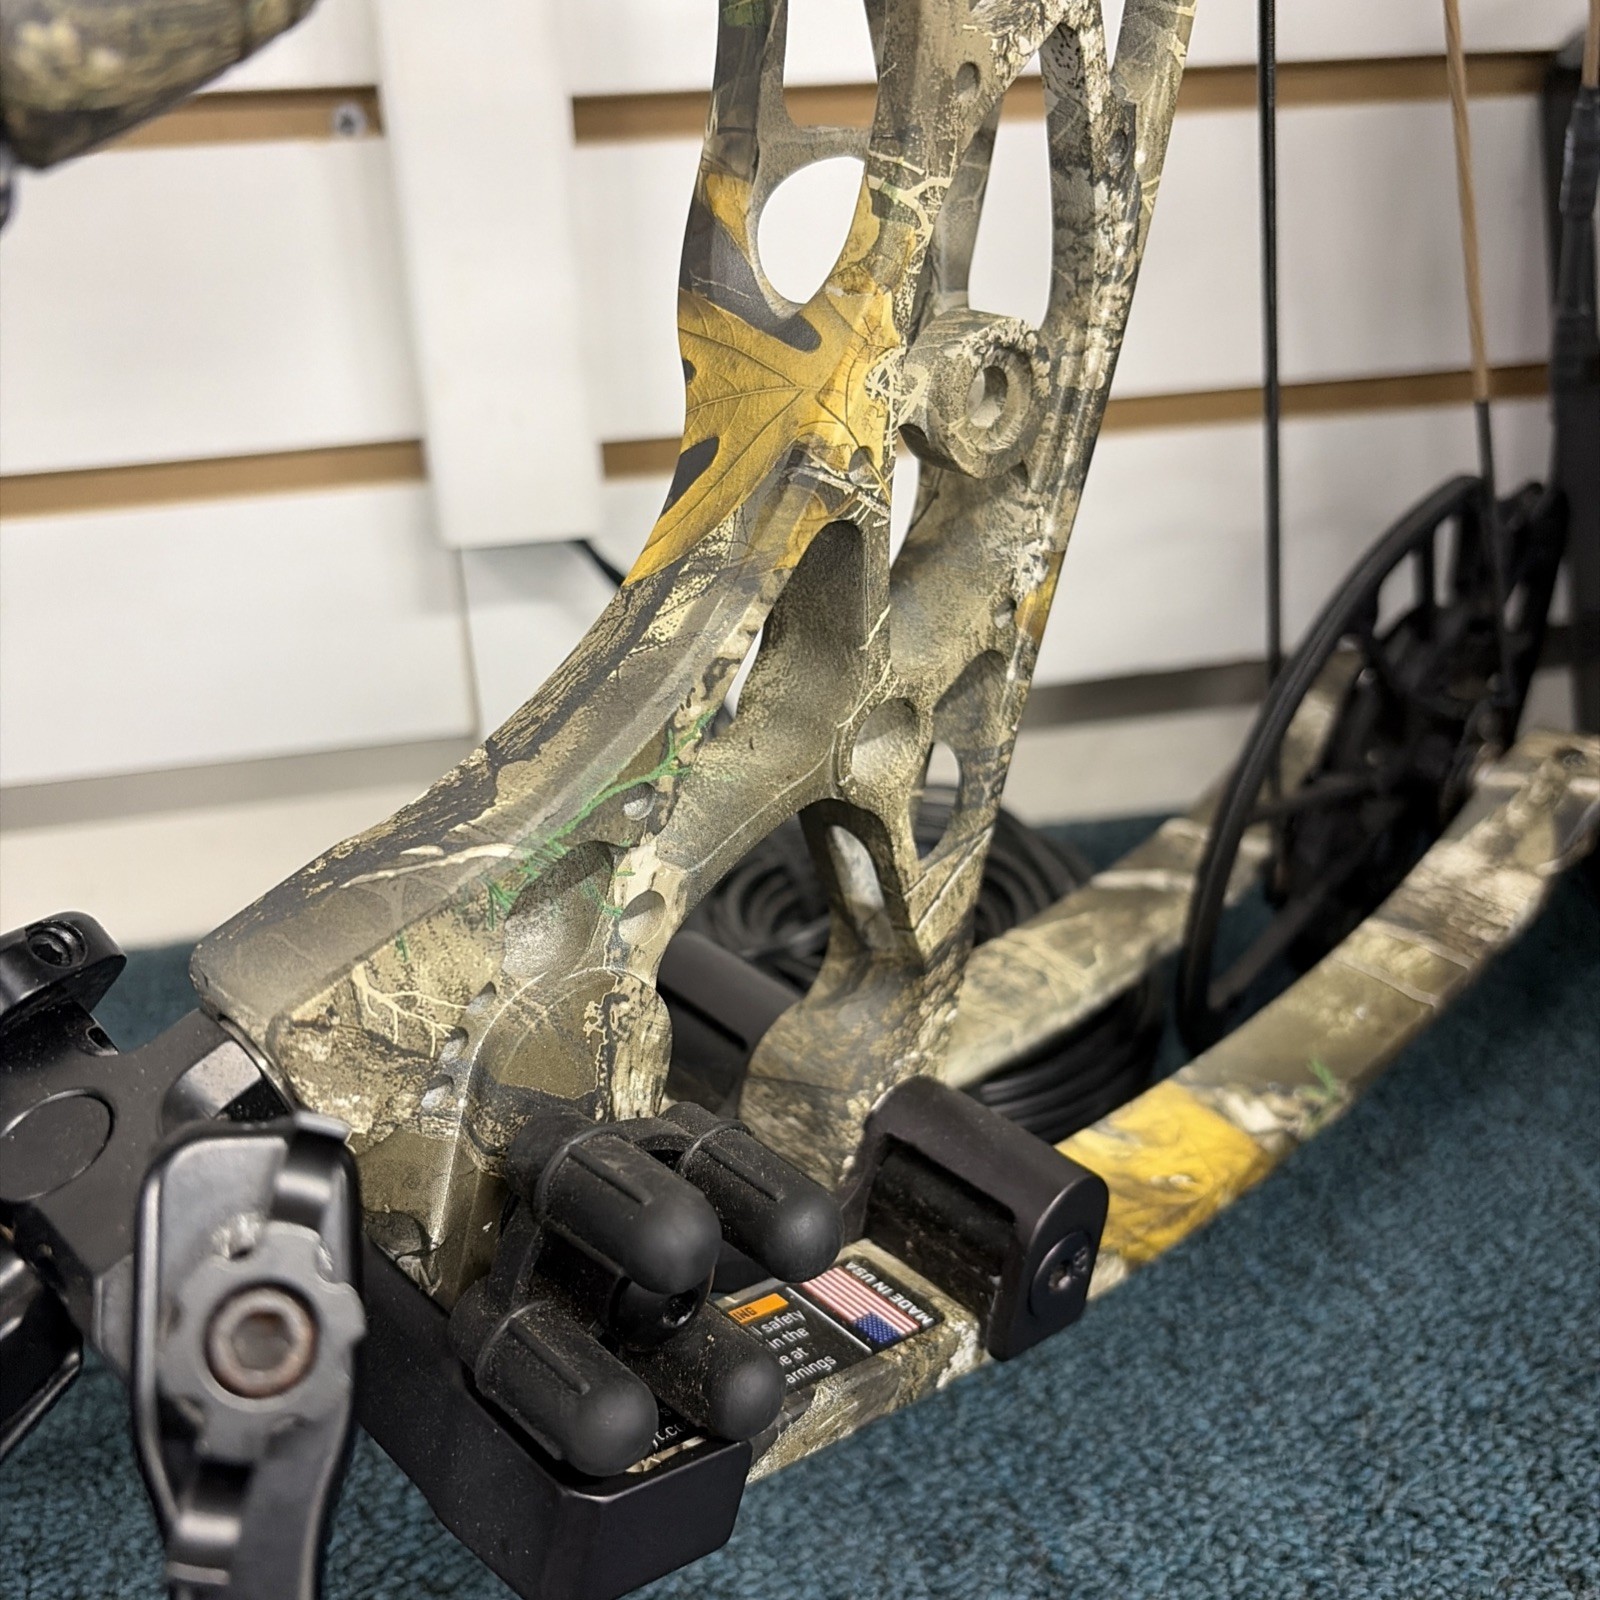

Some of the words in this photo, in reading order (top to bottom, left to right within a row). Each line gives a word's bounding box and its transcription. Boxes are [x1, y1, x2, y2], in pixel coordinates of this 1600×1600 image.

[845, 1261, 878, 1284] USA
[871, 1281, 895, 1297] IN
[732, 1307, 758, 1321] ING
[888, 1293, 934, 1328] MADE
[761, 1310, 806, 1334] safety
[766, 1339, 786, 1349] in
[782, 1327, 809, 1342] the
[790, 1347, 809, 1360] at
[785, 1355, 837, 1384] arnings
